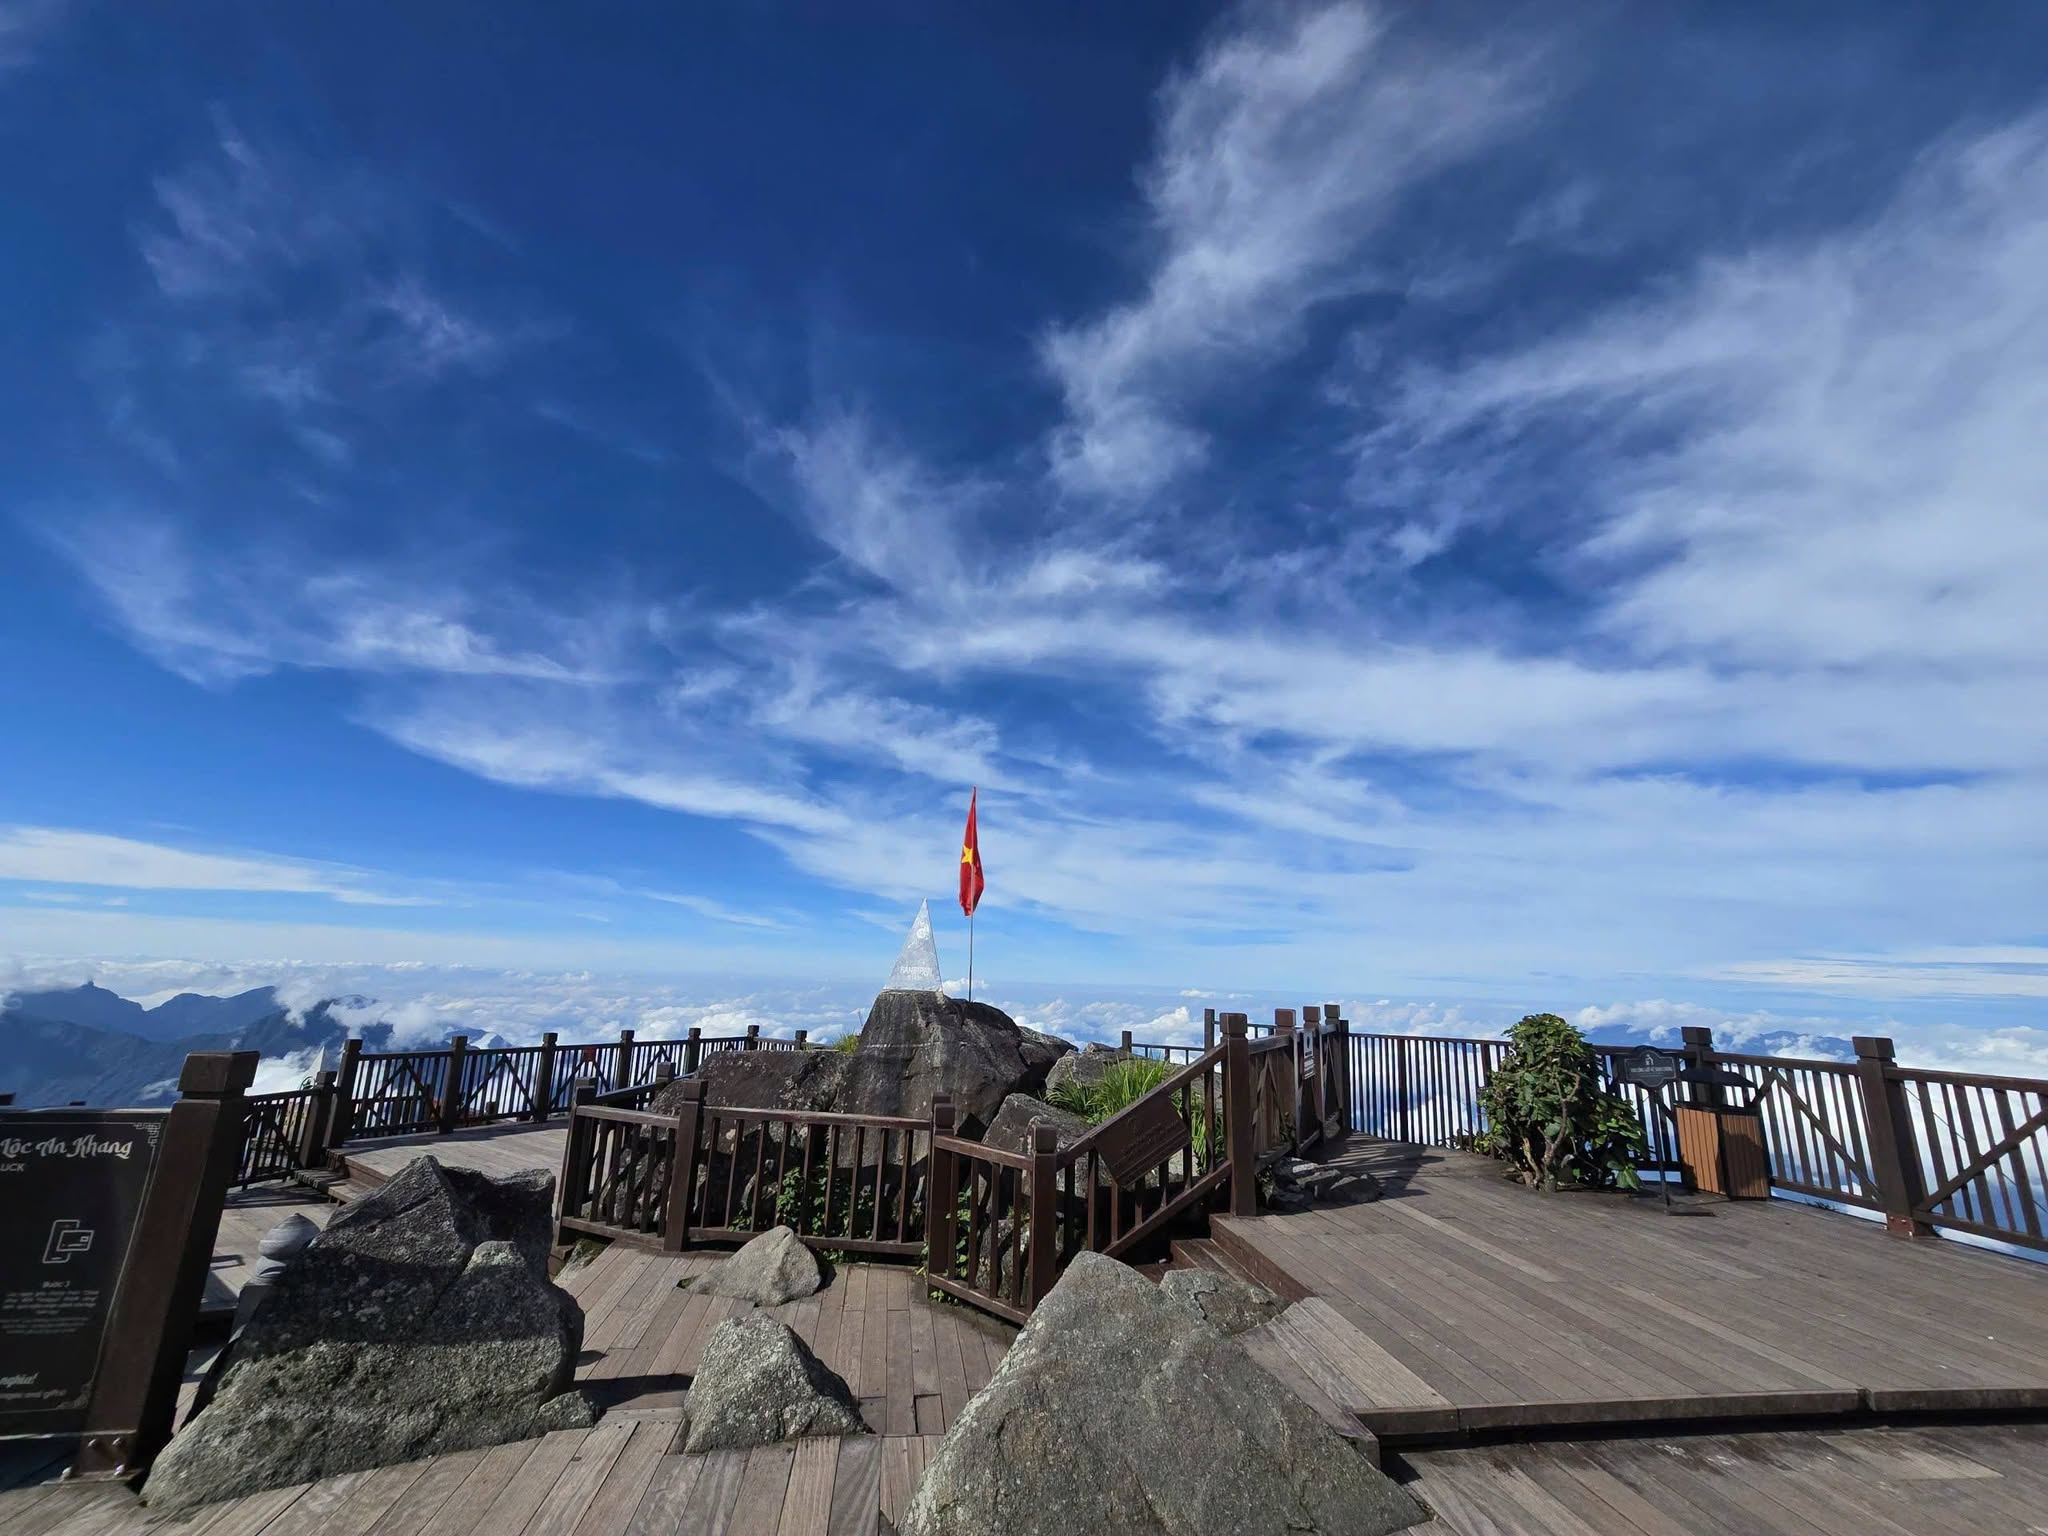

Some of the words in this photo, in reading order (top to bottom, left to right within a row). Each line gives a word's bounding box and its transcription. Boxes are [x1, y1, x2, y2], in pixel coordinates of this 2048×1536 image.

[35, 1137, 67, 1157] An
[66, 1134, 133, 1159] Khang
[0, 1163, 25, 1172] UCK
